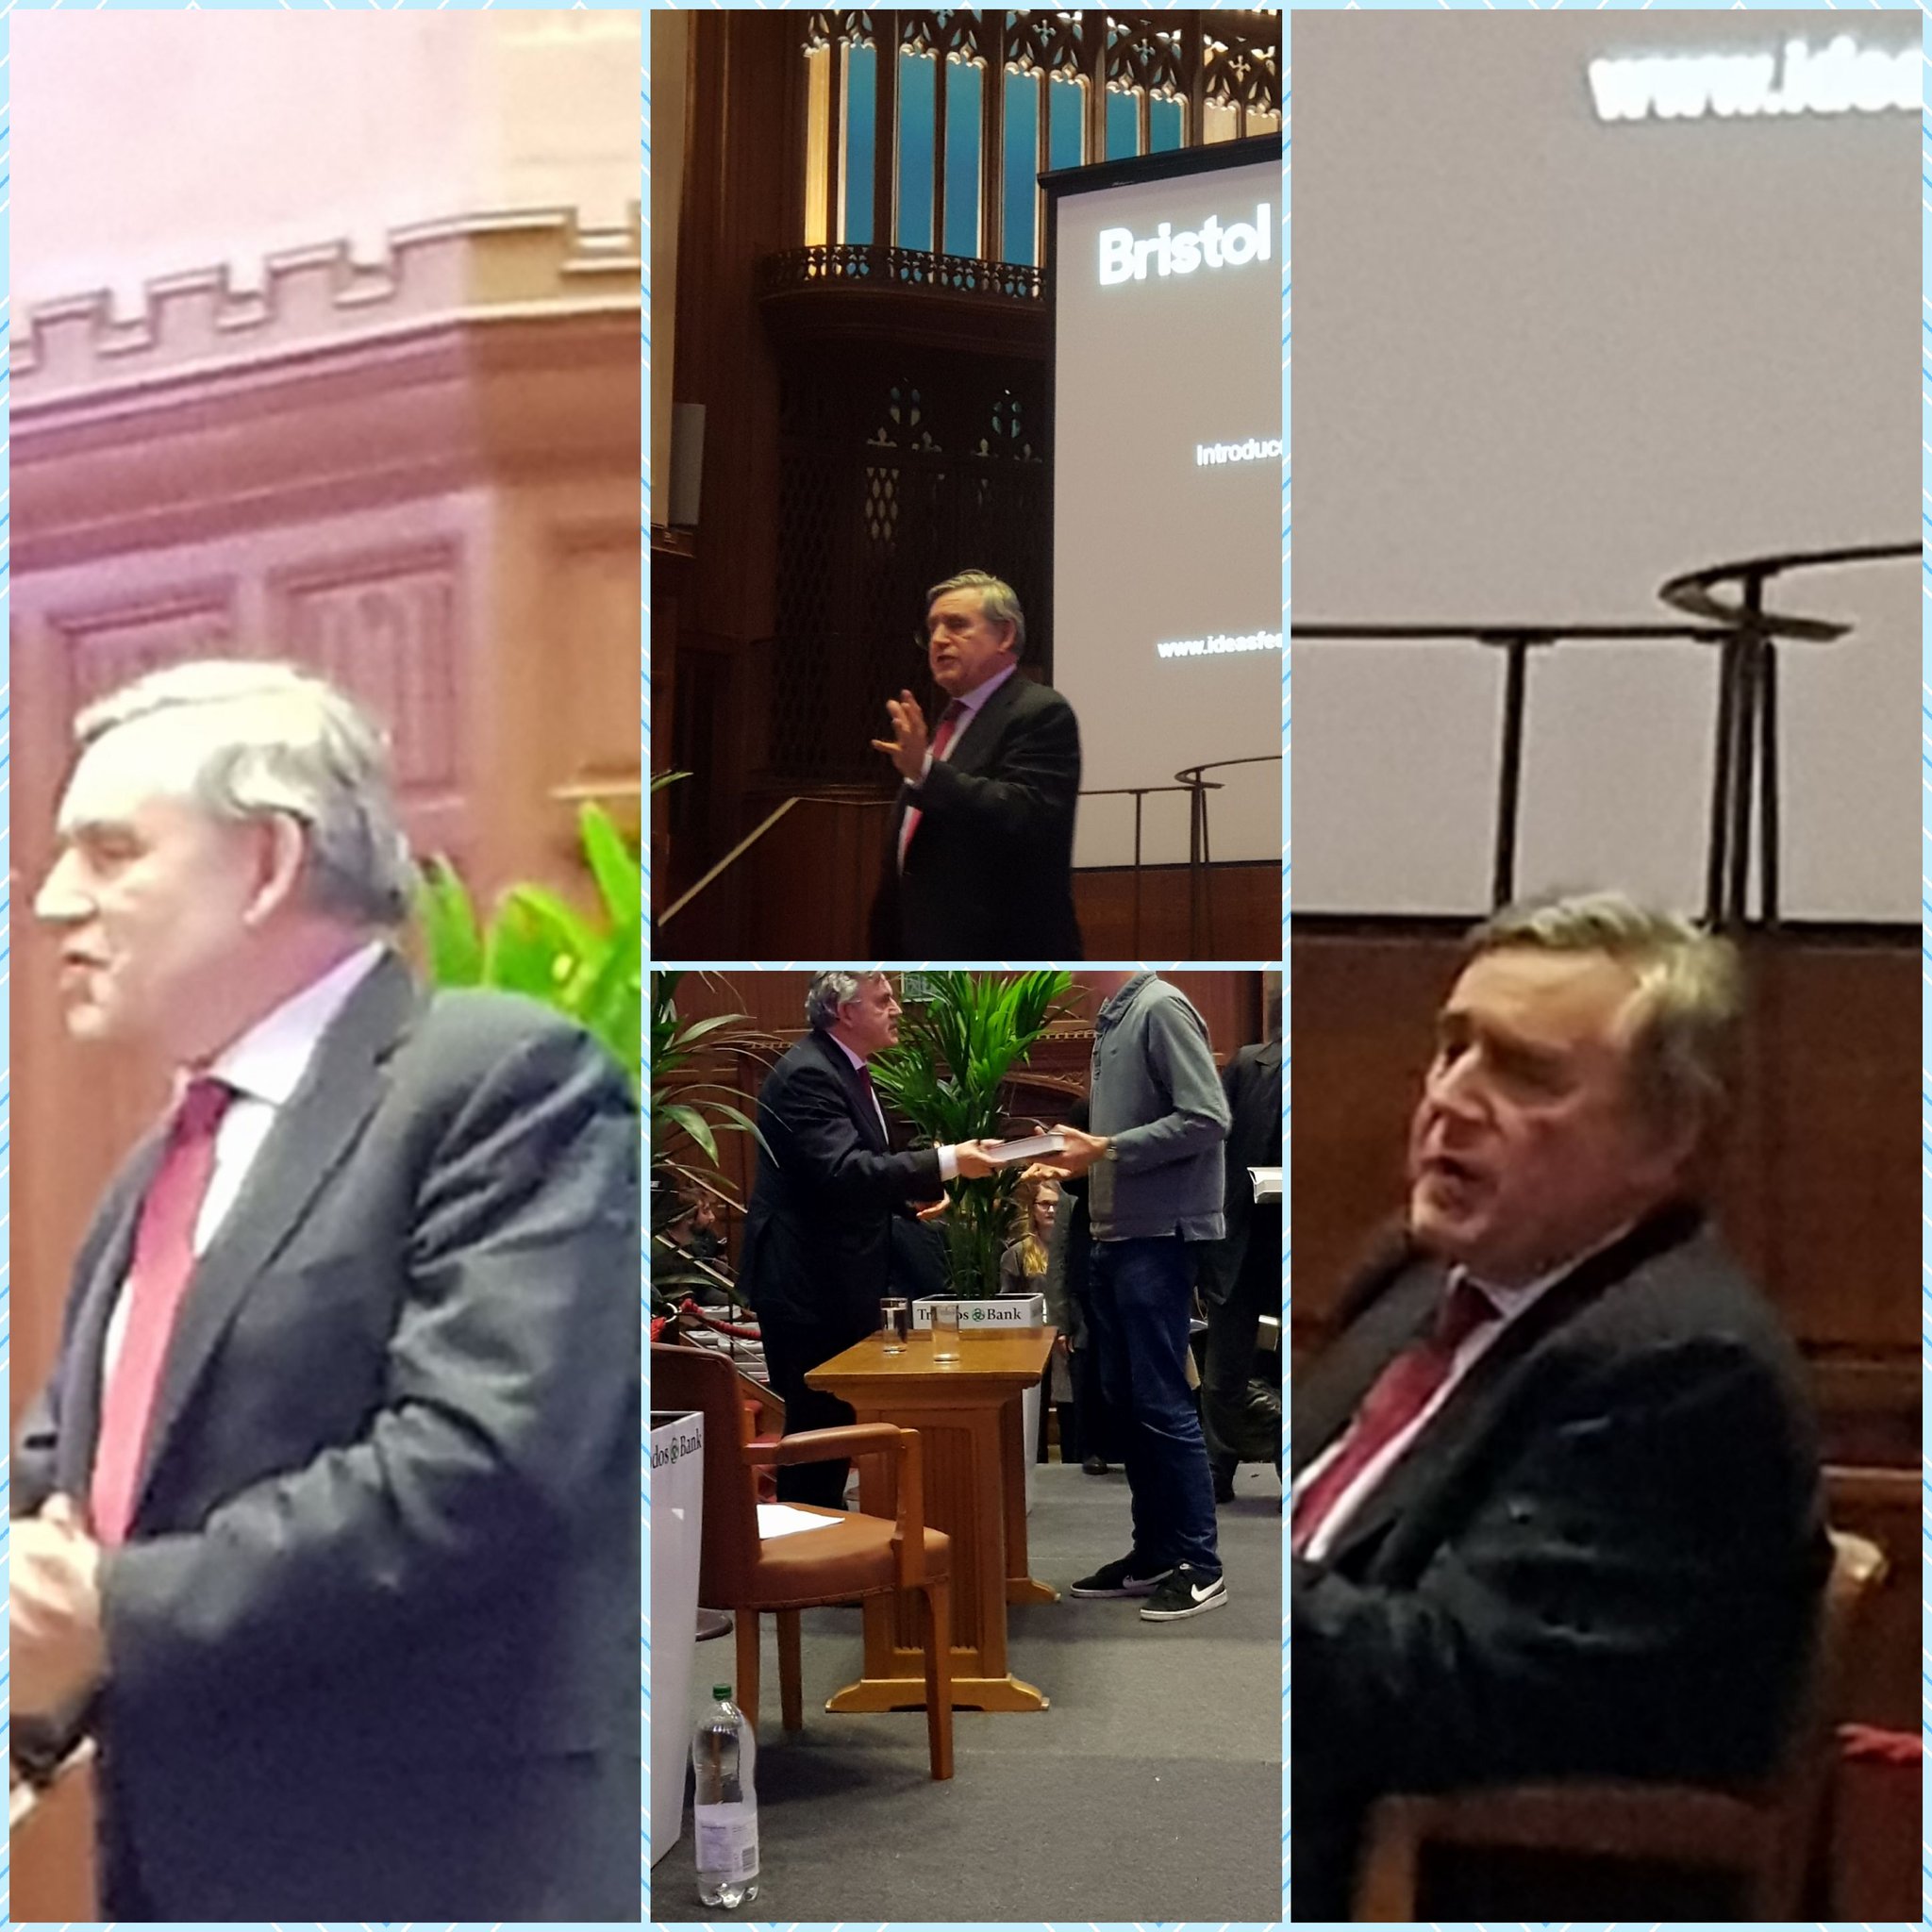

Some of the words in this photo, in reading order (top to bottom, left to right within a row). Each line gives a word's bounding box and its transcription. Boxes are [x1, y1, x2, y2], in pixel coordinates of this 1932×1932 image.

[1098, 203, 1271, 286] Bristol
[1196, 438, 1282, 466] Introduc
[917, 1307, 969, 1320] Tros
[987, 1307, 1022, 1320] Bank
[651, 1444, 669, 1468] dos
[680, 1427, 702, 1457] Bank
